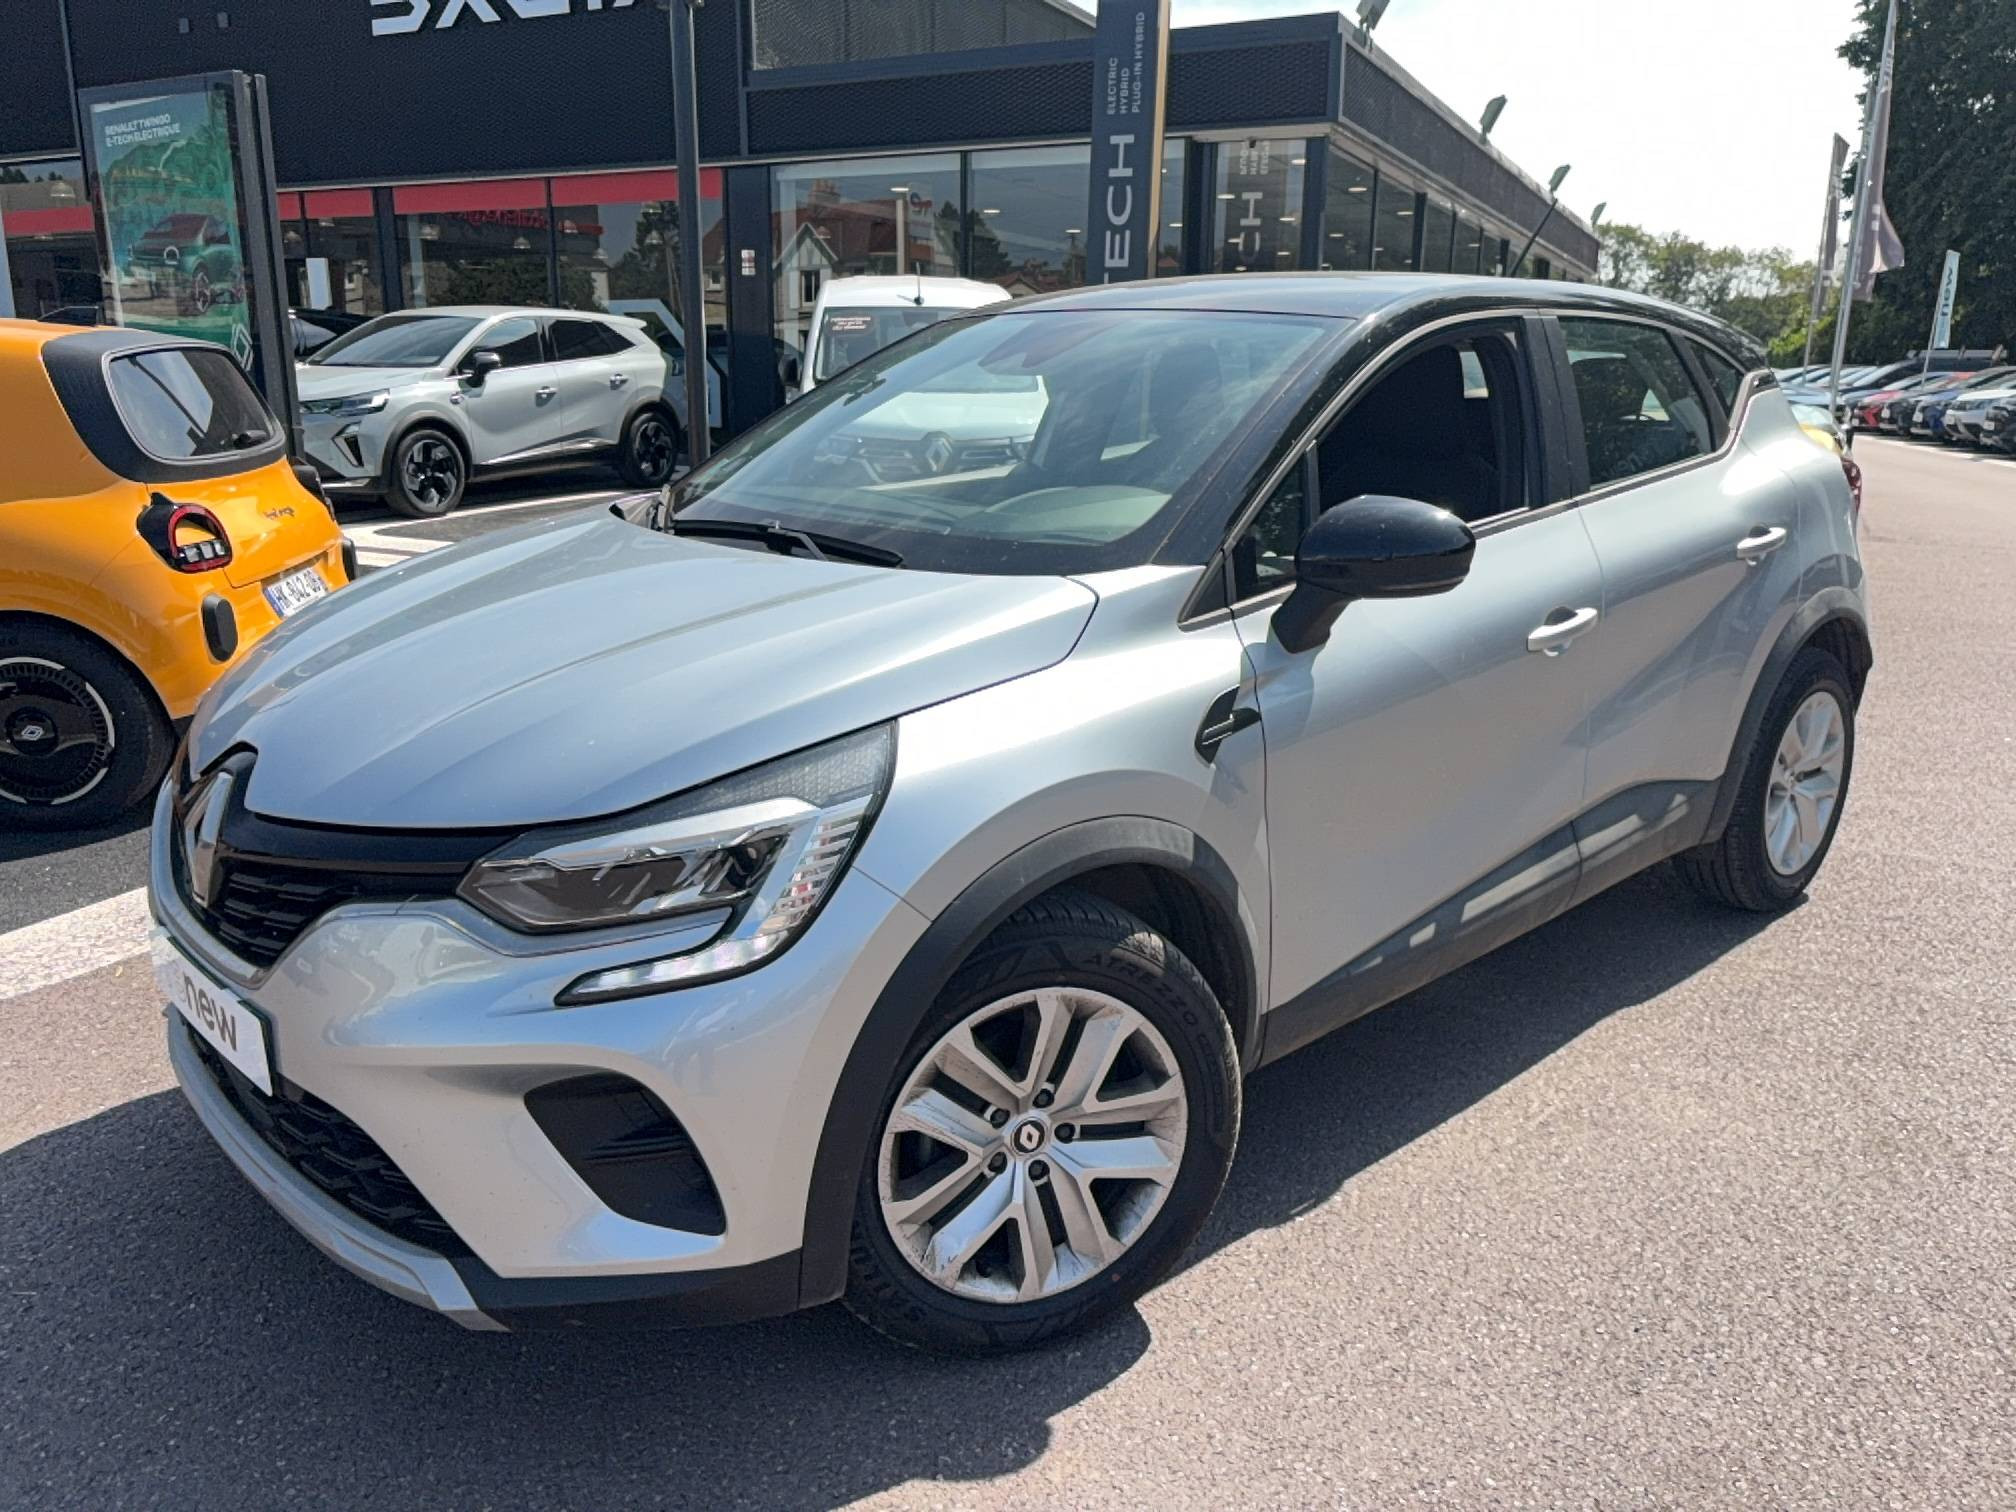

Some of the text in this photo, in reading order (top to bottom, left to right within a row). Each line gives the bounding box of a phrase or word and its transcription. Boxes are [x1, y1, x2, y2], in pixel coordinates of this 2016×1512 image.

[1107, 57, 1119, 114] ELECTRIC
[1119, 67, 1131, 114] HYBRID
[1132, 11, 1145, 113] PLUG-IN HYBRID
